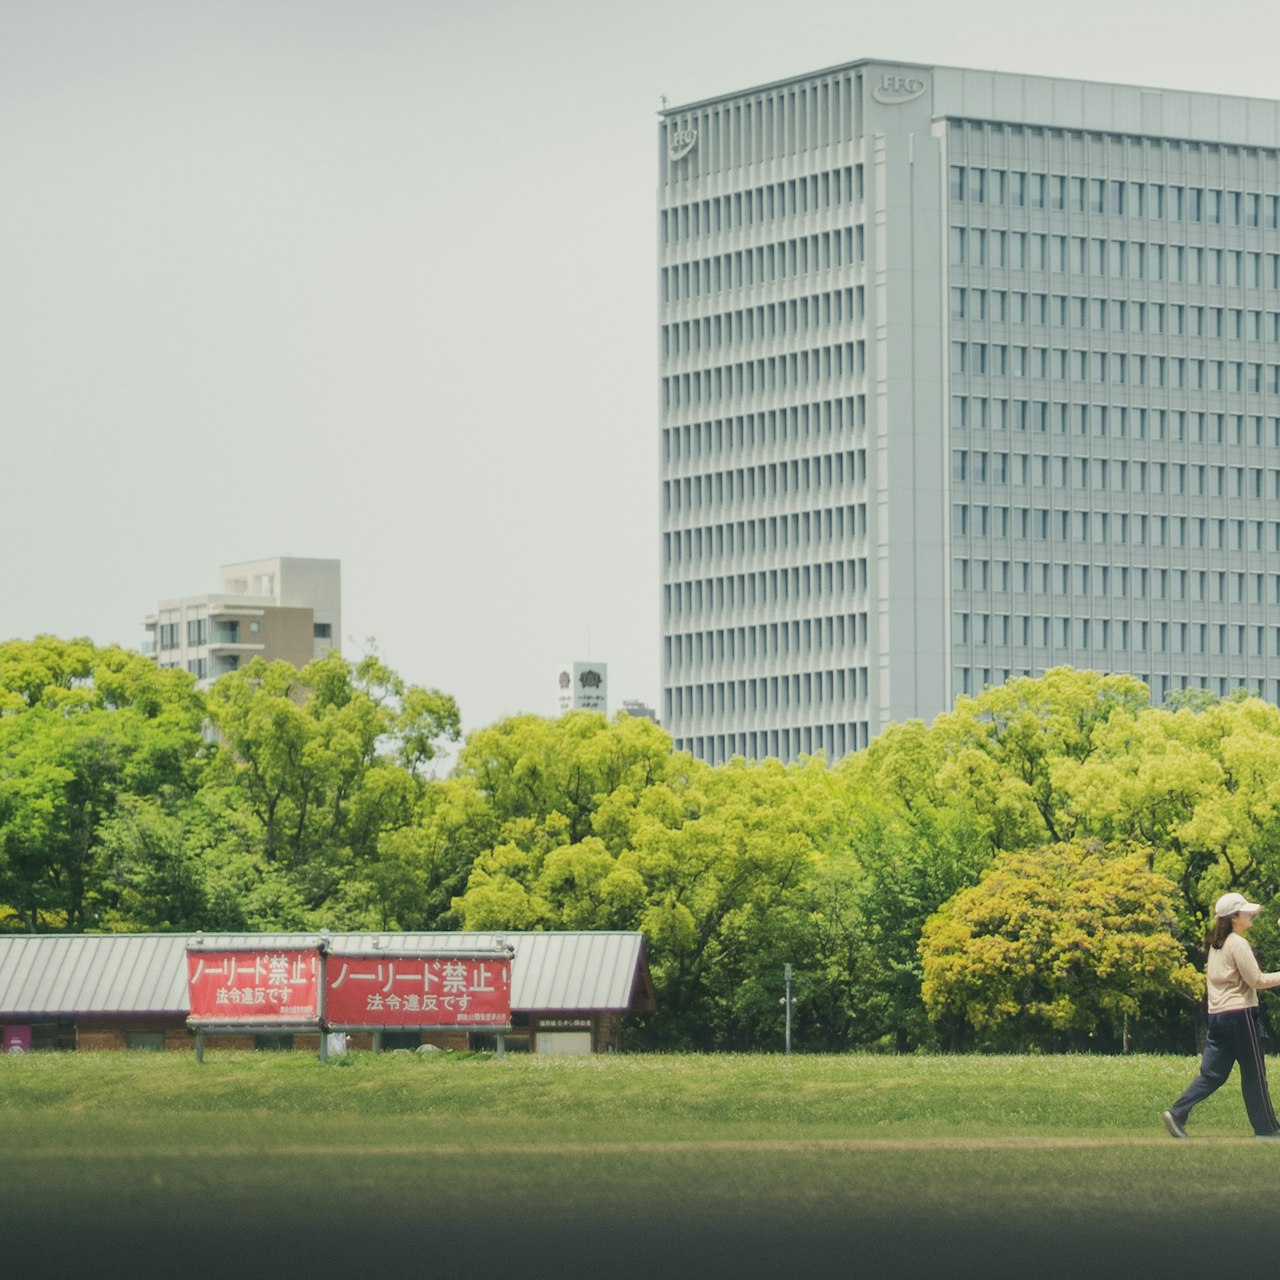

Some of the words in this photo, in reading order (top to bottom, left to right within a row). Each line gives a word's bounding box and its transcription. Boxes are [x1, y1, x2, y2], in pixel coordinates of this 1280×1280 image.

[882, 74, 916, 92] FFG
[191, 954, 316, 986] ノーリード禁止！
[331, 962, 508, 993] ノーリード禁止！
[216, 987, 293, 1004] 法令違反です
[366, 994, 473, 1011] 法令違反です
